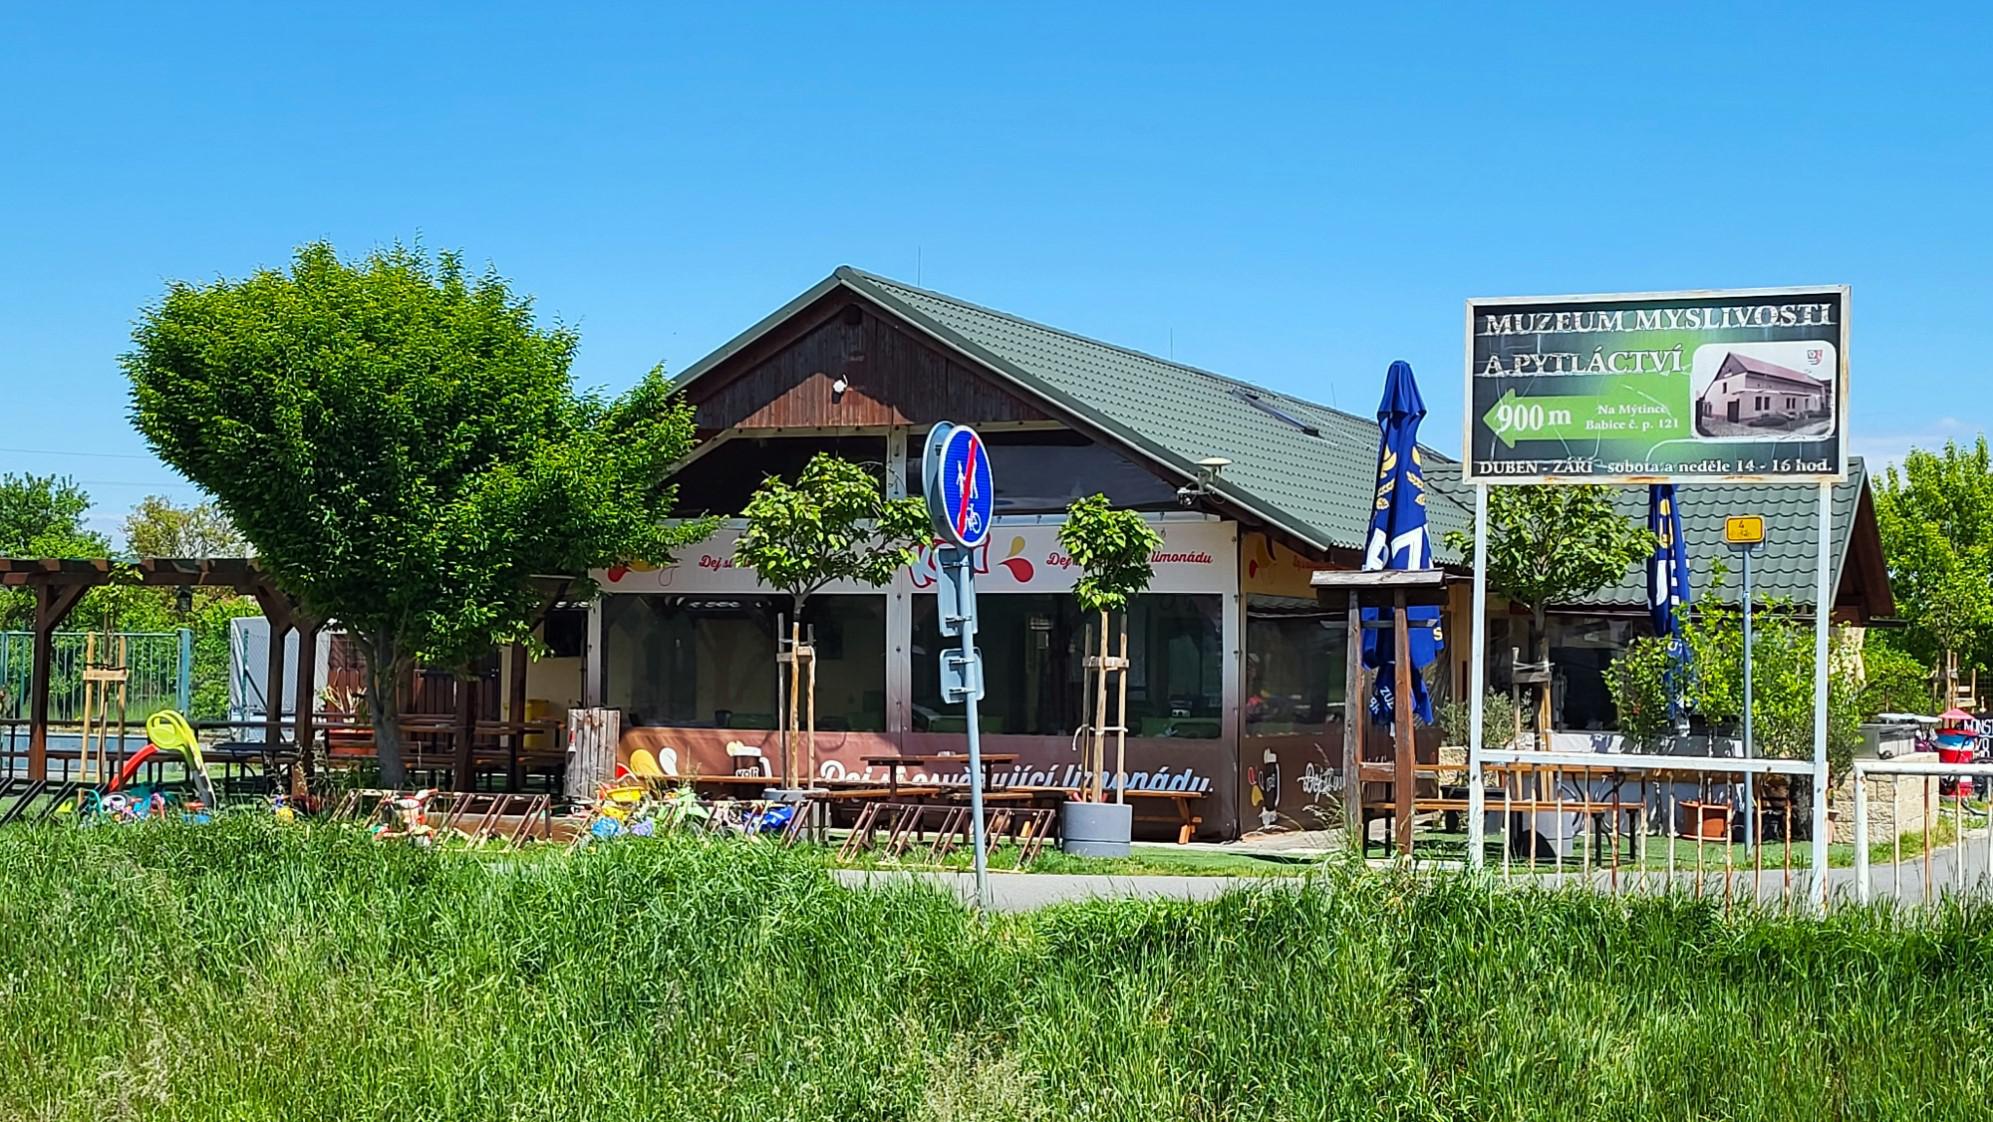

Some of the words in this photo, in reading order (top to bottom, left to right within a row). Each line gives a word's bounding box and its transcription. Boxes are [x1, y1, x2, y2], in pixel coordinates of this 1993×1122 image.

[1486, 310, 1625, 334] MUZEUM
[1635, 303, 1832, 331] MYSLIVOSTI
[1483, 353, 1503, 377] A
[1511, 344, 1684, 377] PYTLÁCTVÍ
[1497, 404, 1544, 432] 900
[1548, 409, 1571, 425] m
[1597, 405, 1615, 415] Na
[1618, 404, 1668, 417] Mýtince
[1585, 419, 1625, 431] Babice
[1642, 420, 1654, 432] p.
[1658, 418, 1680, 429] 121
[1479, 462, 1538, 475] DUBEN
[1608, 459, 1659, 474] sobota
[1678, 460, 1732, 474] neděle
[1737, 459, 1755, 473] 14
[1772, 459, 1791, 472] 16
[1795, 458, 1833, 472] hod.
[698, 554, 722, 572] Dej
[1046, 552, 1072, 570] Dej
[1150, 551, 1214, 564] limonádu
